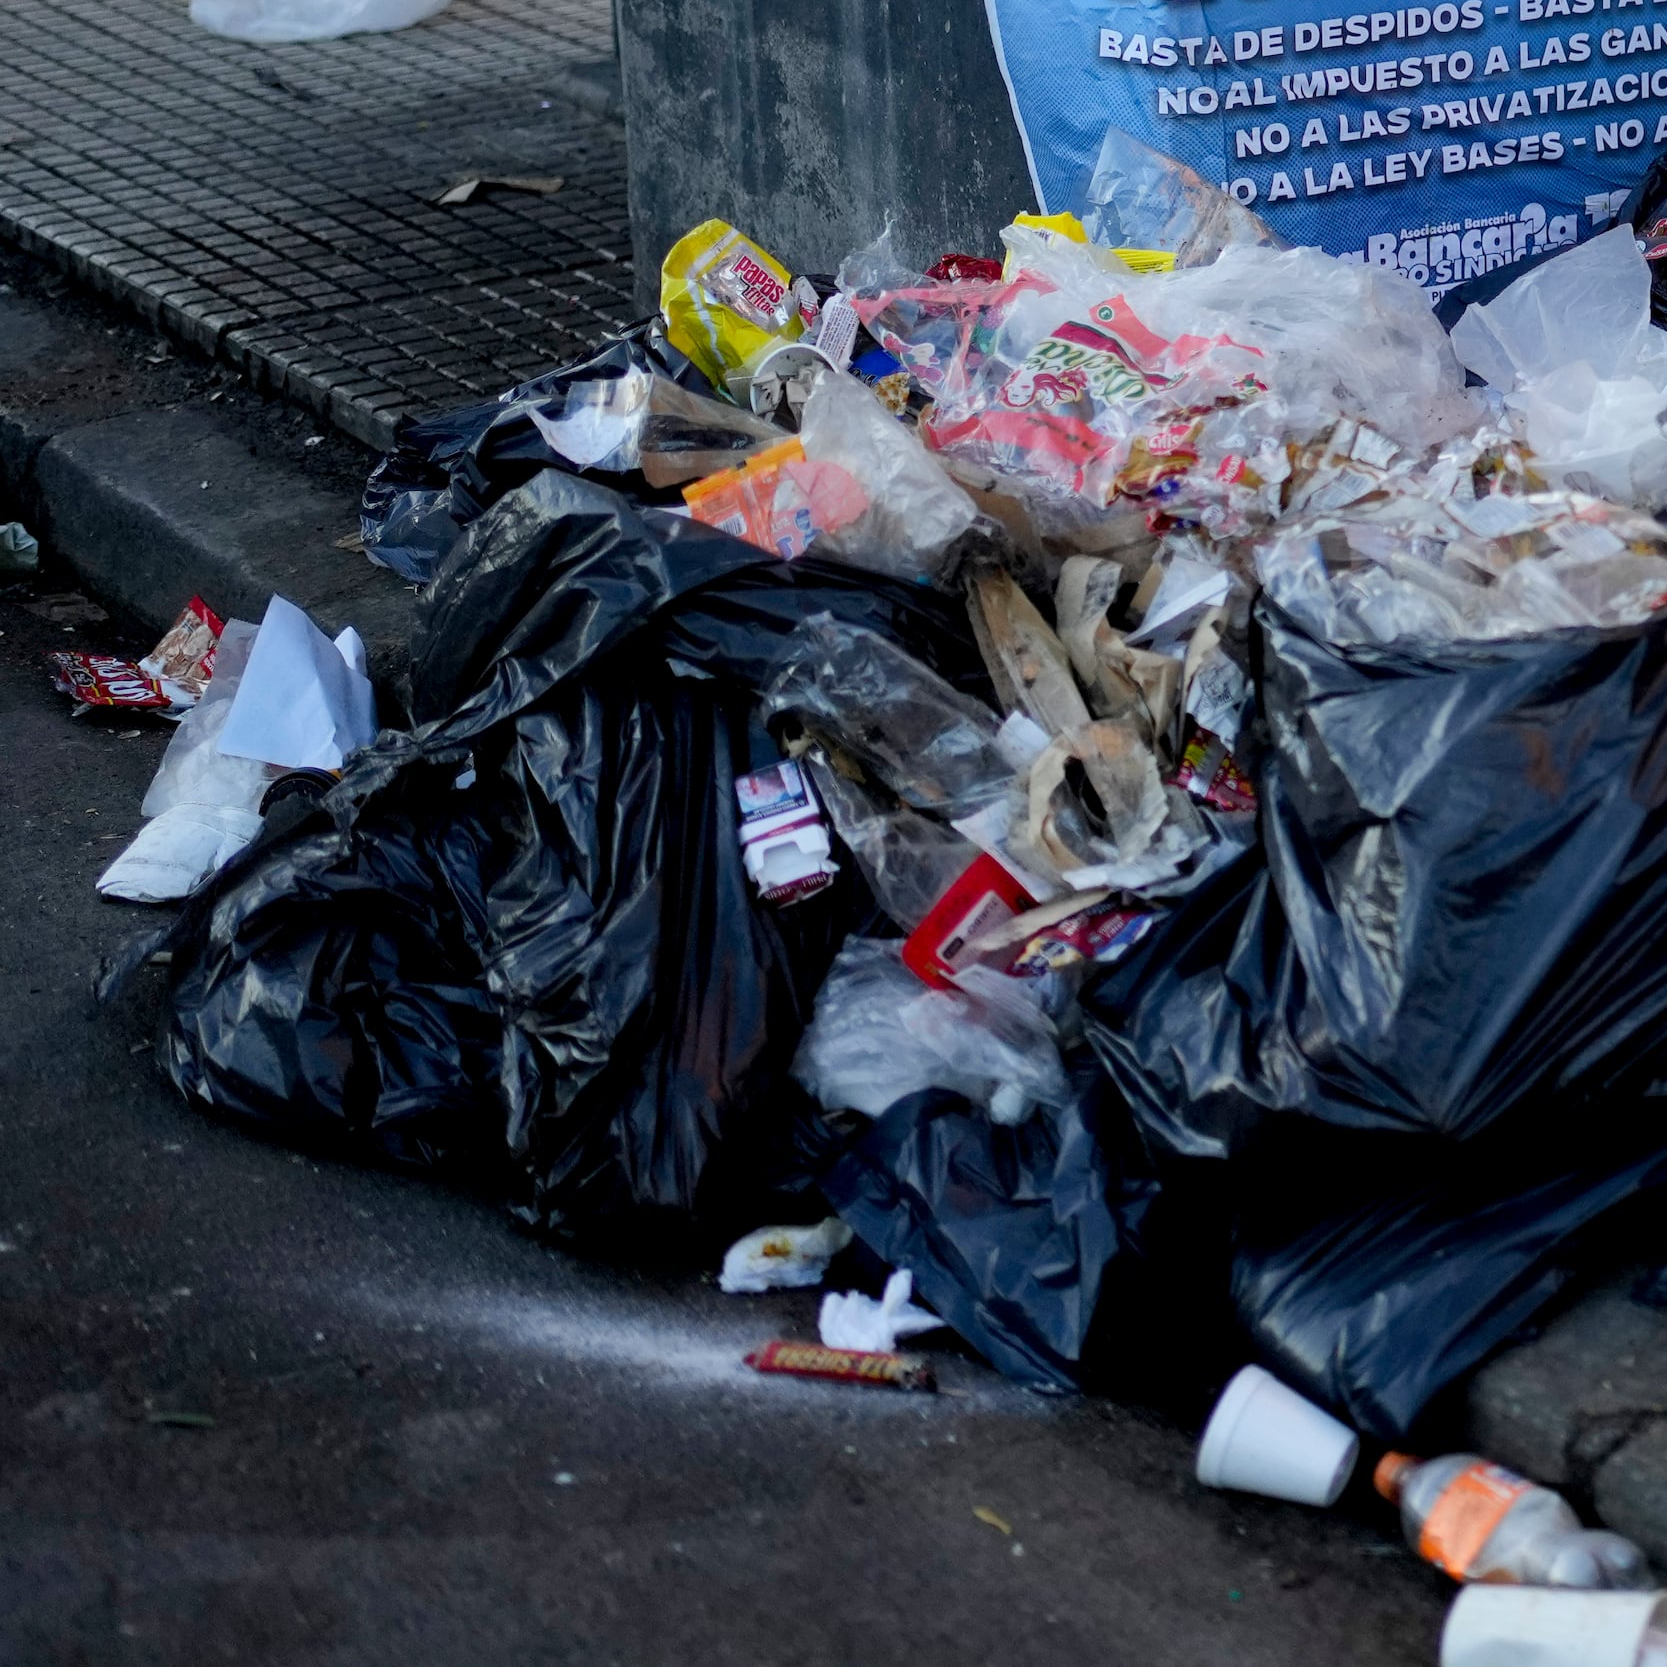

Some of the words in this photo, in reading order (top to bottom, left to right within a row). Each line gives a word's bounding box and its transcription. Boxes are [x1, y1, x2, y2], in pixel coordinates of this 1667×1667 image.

[1099, 26, 1226, 68] BASTA
[1233, 28, 1283, 61] DE
[1295, 1, 1483, 55] DESPIDOS
[1158, 81, 1220, 117] NO
[1226, 75, 1277, 107] AL
[1281, 53, 1469, 103] IMPUESTO
[1483, 44, 1509, 76] A
[1519, 32, 1591, 70] LAS
[1236, 126, 1291, 160] NO
[1301, 117, 1329, 150] A
[1338, 103, 1413, 143] LAS
[1267, 169, 1298, 201] A
[1305, 161, 1354, 195] LA
[1362, 148, 1432, 186] LEY
[1442, 132, 1563, 173] BASES
[1597, 118, 1644, 150] NO
[1400, 221, 1461, 240] Asociación
[1464, 212, 1516, 229] Bancaria
[731, 255, 785, 304] papas
[743, 287, 776, 317] fritas
